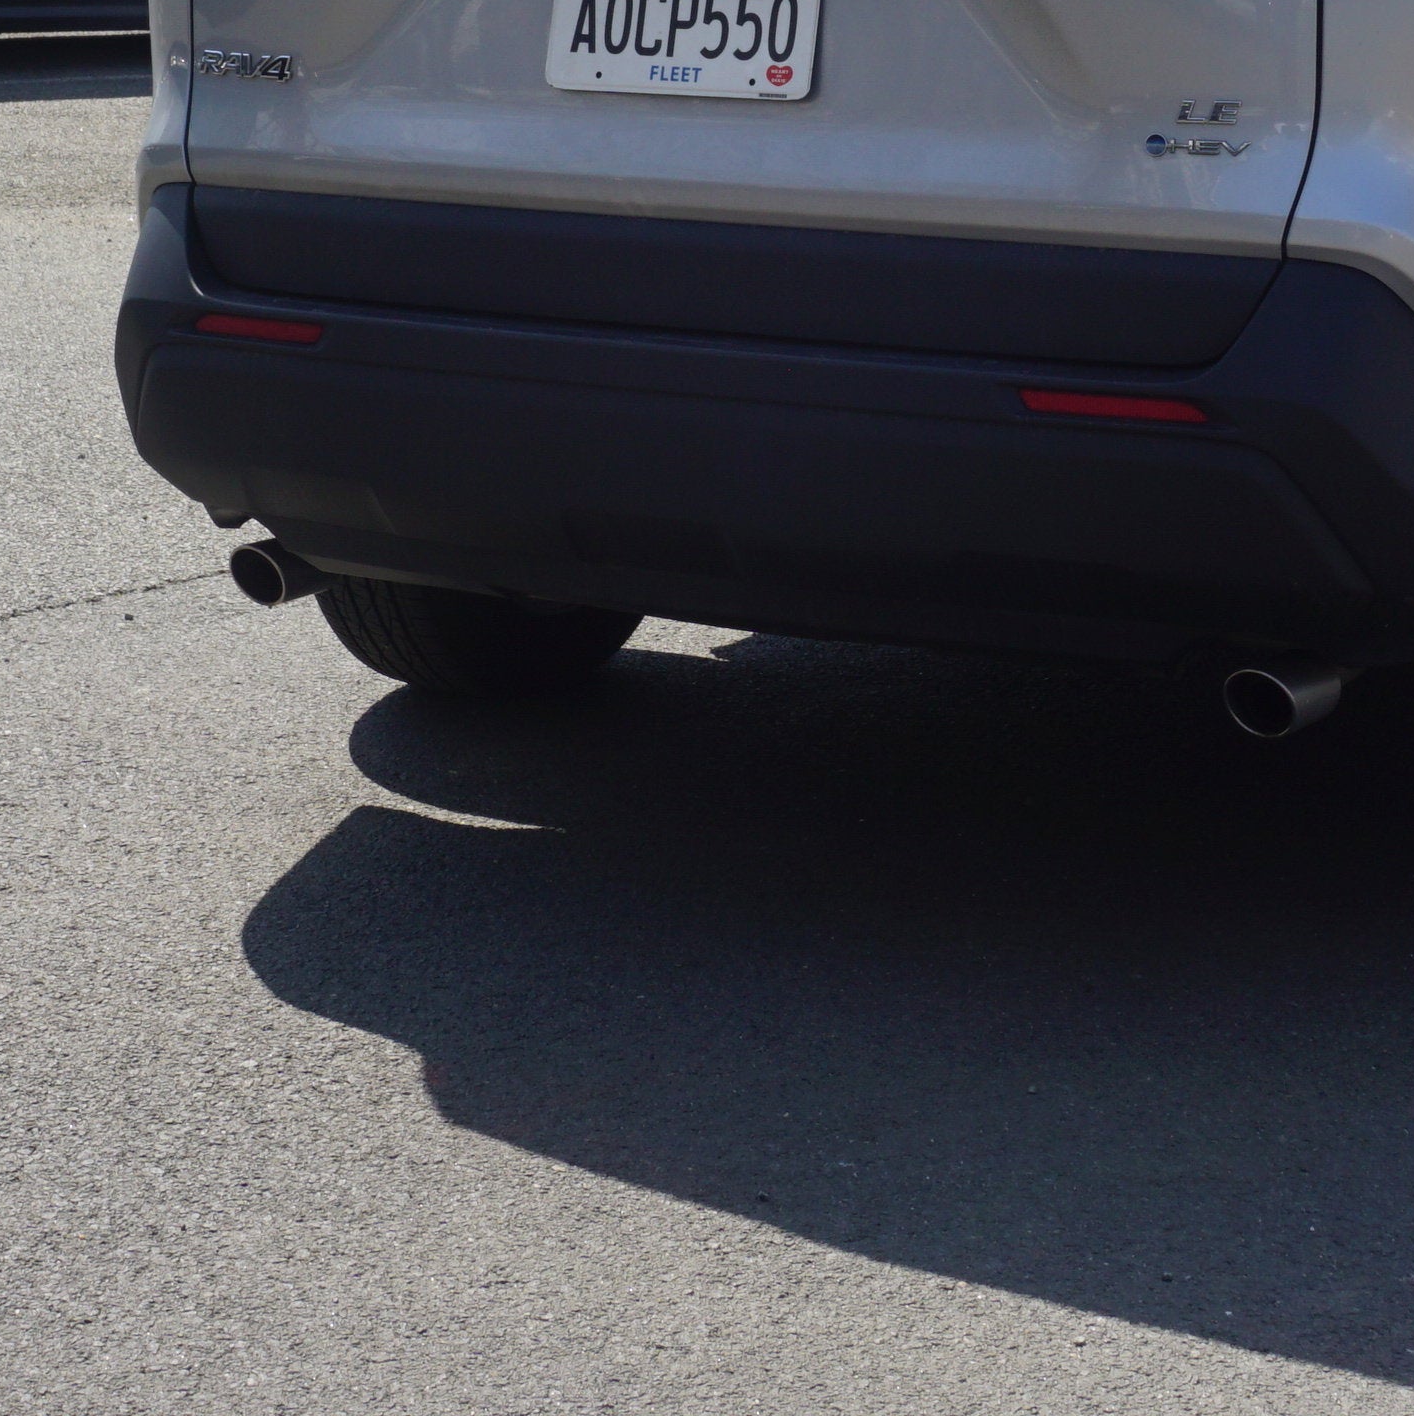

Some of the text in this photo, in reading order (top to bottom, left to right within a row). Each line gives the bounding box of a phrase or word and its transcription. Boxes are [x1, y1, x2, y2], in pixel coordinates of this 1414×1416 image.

[199, 49, 293, 83] RAV4
[650, 65, 703, 84] FLEET
[1176, 98, 1242, 125] LE
[1167, 138, 1252, 157] HEV
